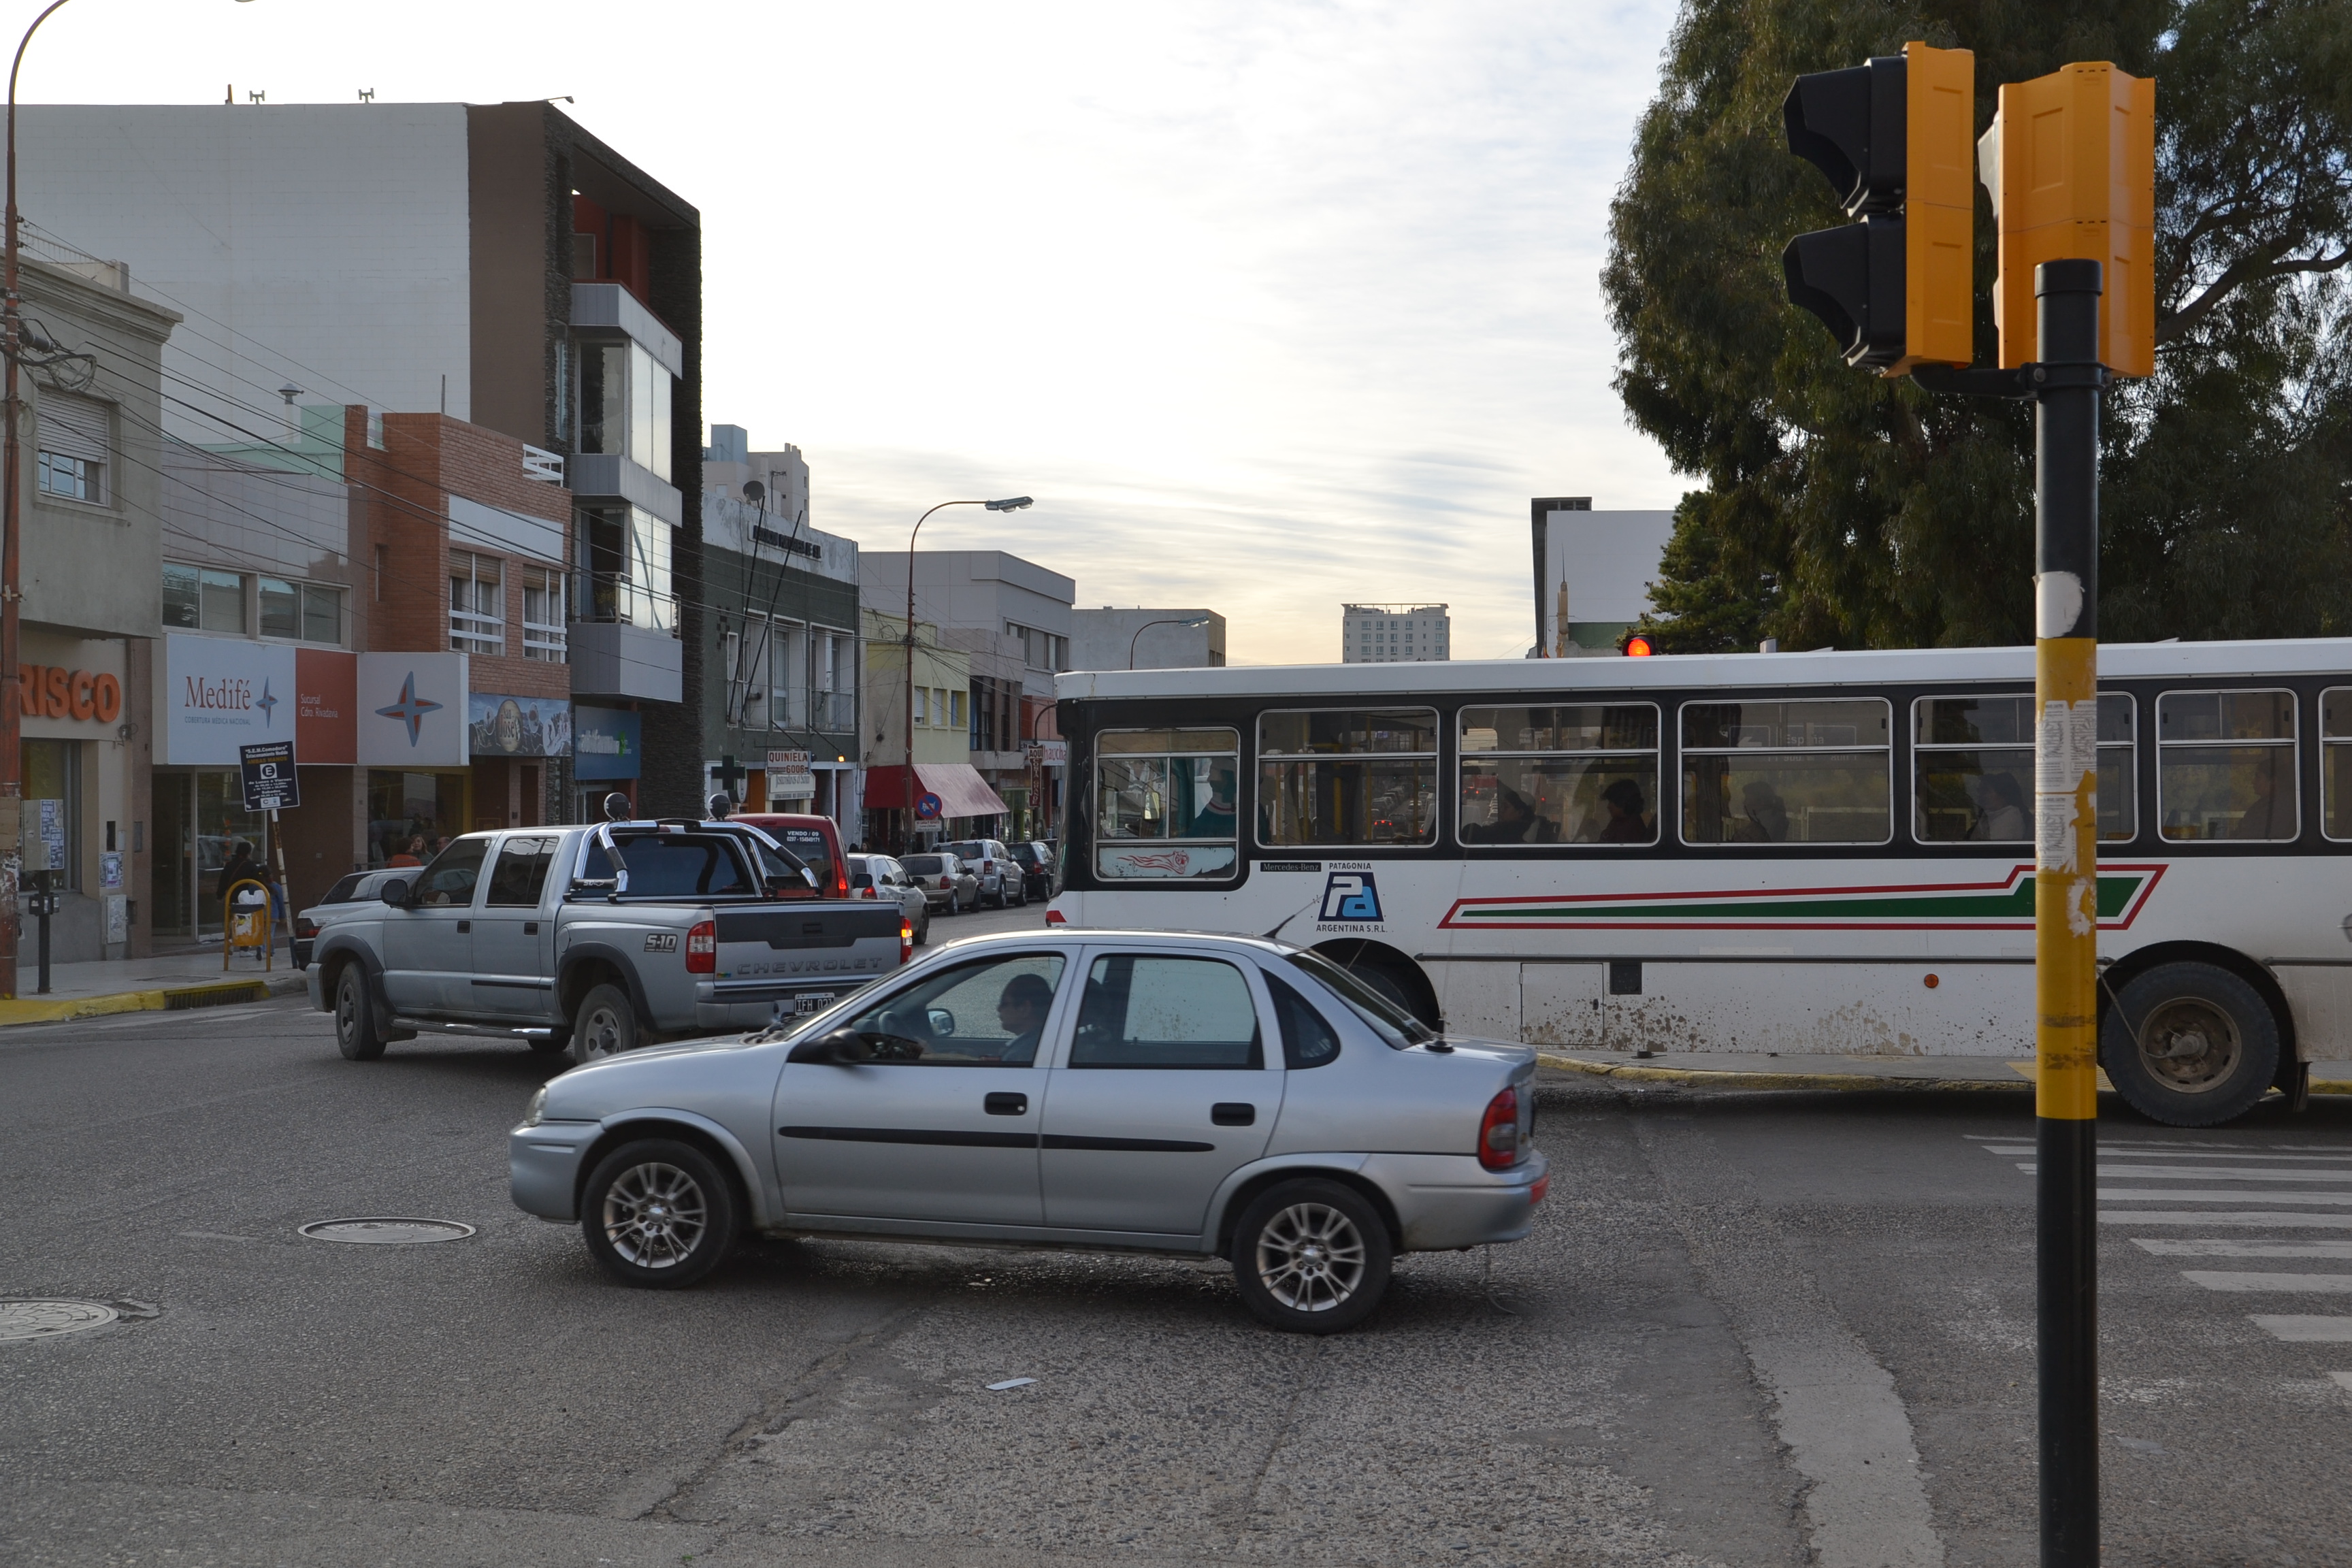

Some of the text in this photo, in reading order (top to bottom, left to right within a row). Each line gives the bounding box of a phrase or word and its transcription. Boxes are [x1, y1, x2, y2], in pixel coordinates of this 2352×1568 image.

[18, 663, 121, 723] RISCO
[185, 676, 250, 710] Medifé
[301, 693, 321, 704] Sucursal
[315, 707, 338, 718] Rivadavia
[184, 716, 210, 724] COBERTURA
[212, 716, 228, 725] MÉDICA
[769, 753, 808, 762] QUINIELA
[265, 767, 272, 775] E
[786, 765, 804, 774] 6006
[1263, 863, 1320, 871] Mercedes-Benz
[1316, 924, 1388, 933] ARGENTINA S.R.L.
[646, 934, 677, 949] S-10
[737, 958, 882, 975] CHEVROLET
[797, 999, 813, 1012] IFH
